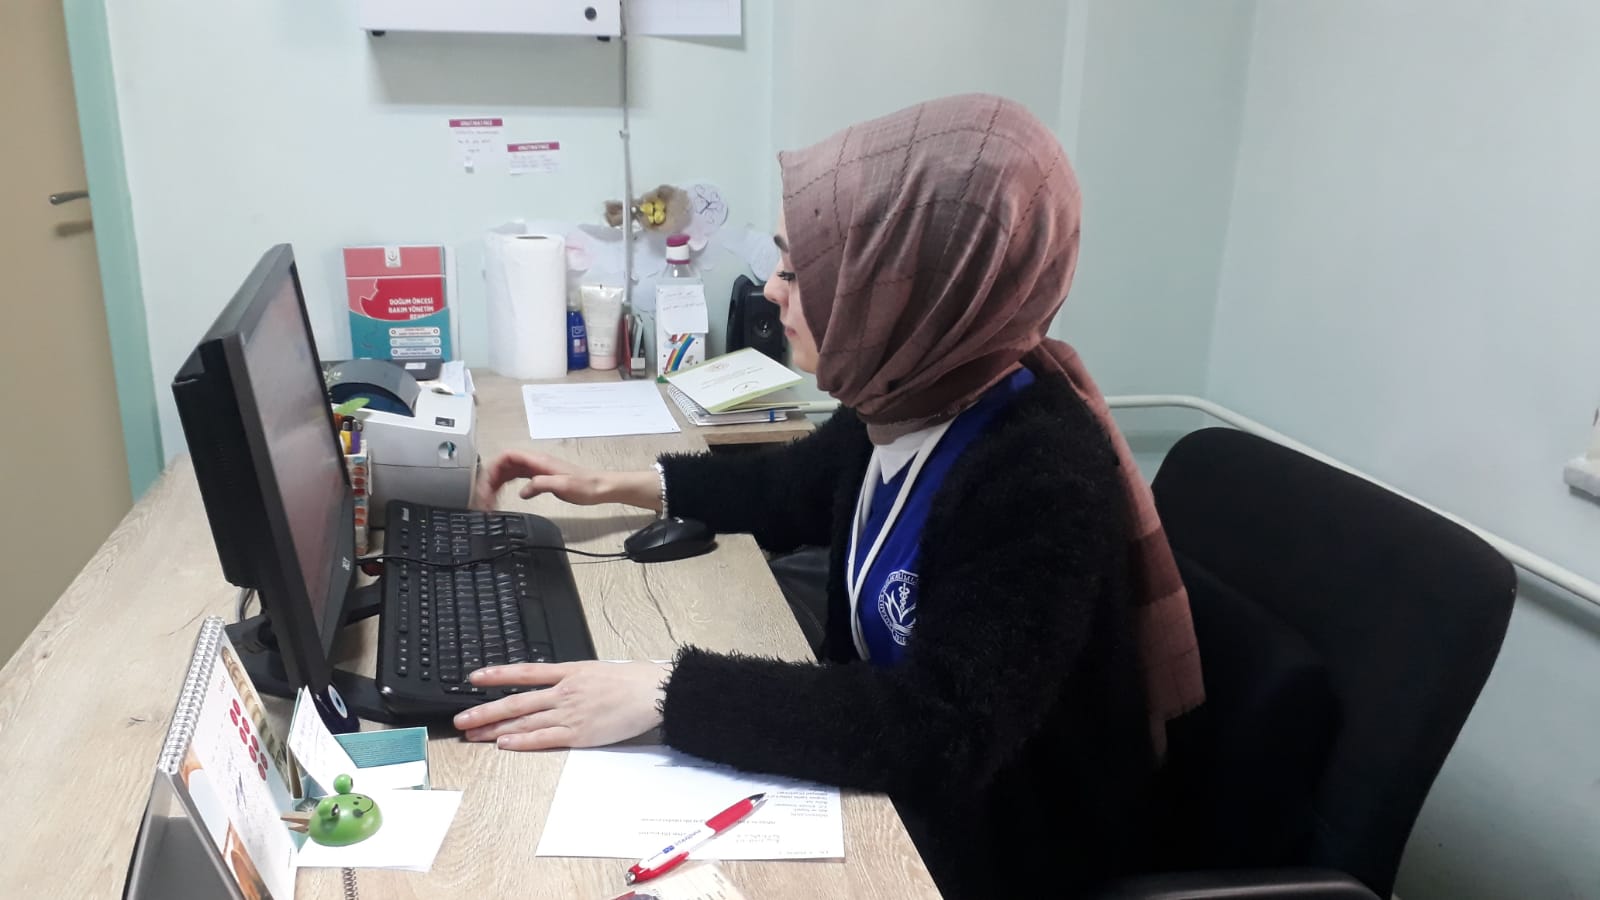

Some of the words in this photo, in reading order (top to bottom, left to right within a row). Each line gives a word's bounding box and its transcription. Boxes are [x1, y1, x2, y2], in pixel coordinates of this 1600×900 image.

[389, 297, 411, 305] DOĞUM
[412, 296, 433, 304] ÖNCESİ
[409, 305, 434, 313] YÖNETİM
